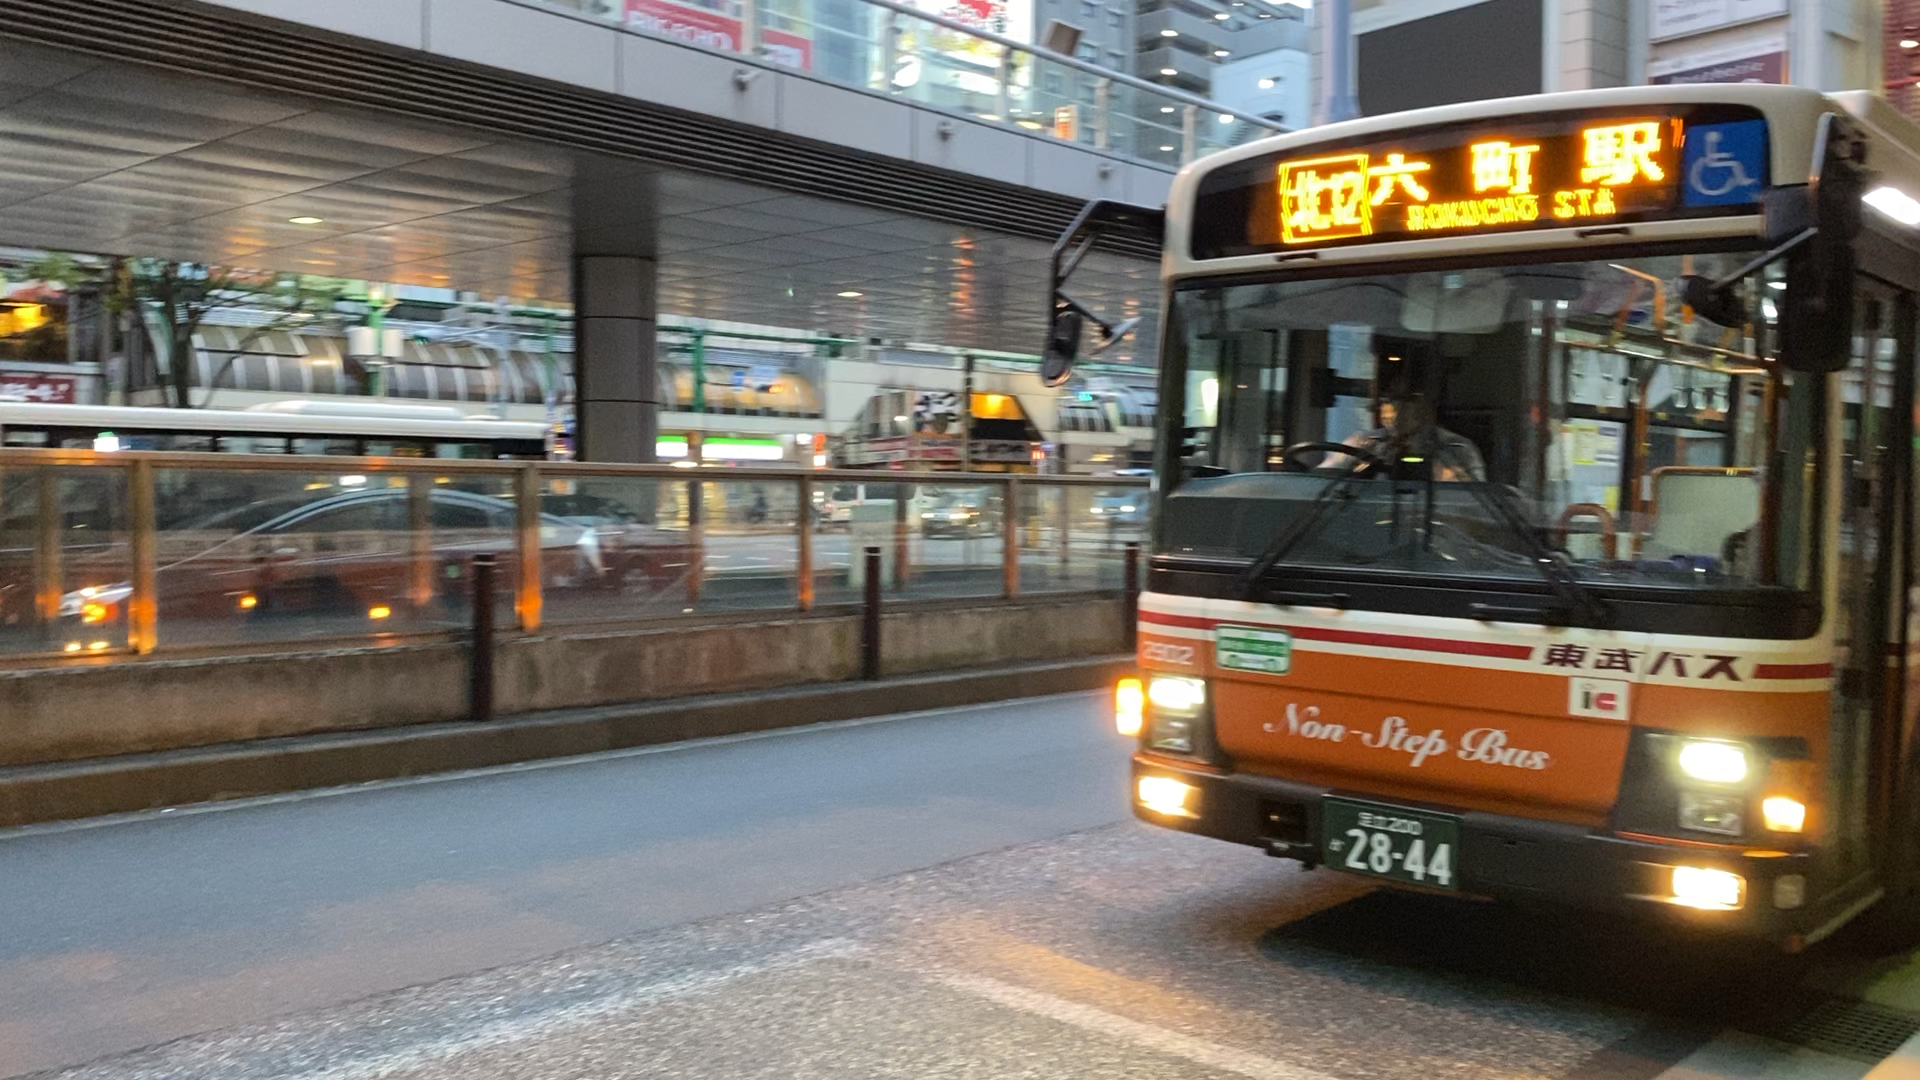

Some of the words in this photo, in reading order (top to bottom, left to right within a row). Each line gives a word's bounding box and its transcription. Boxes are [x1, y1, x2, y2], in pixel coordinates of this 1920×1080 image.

[1542, 643, 1744, 683] 東武バス
[1263, 703, 1449, 767] Non-Step
[1457, 727, 1550, 770] Bus
[1344, 828, 1453, 886] 28-44
